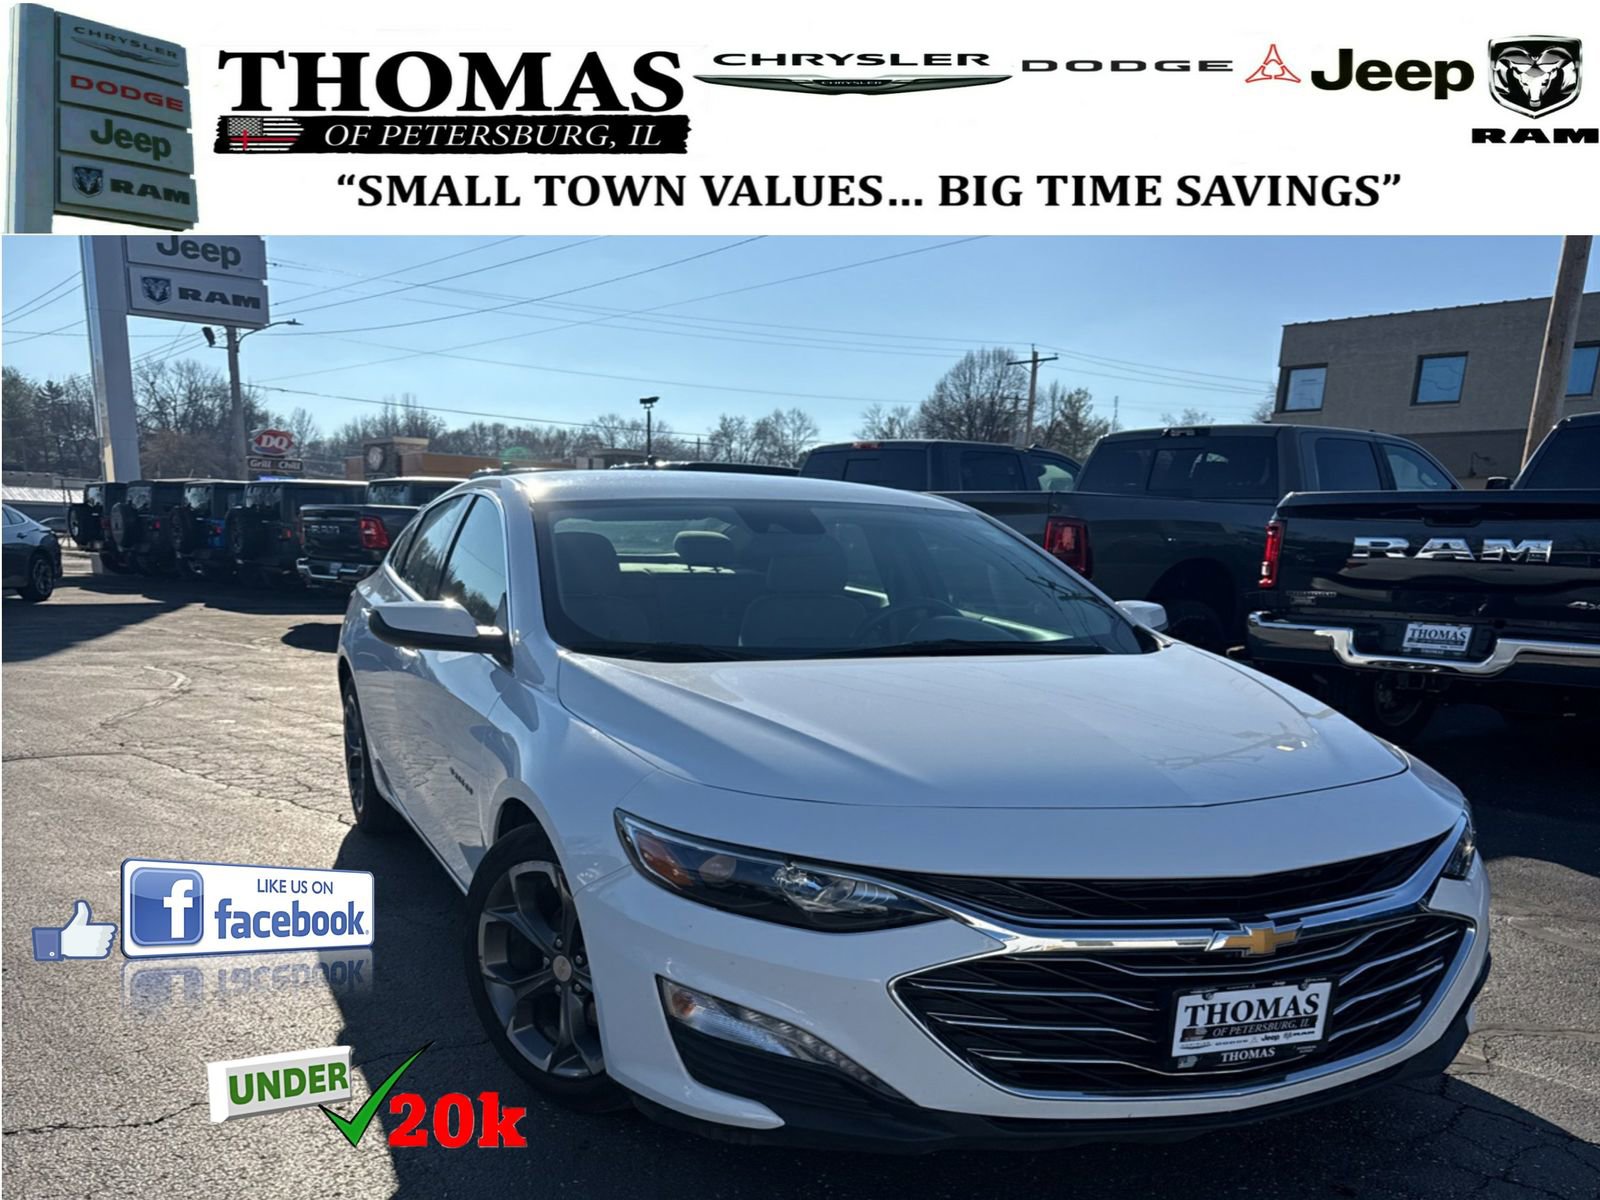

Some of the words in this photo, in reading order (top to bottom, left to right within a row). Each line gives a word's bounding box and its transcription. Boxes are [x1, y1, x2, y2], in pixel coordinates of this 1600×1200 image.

[156, 235, 241, 270] Jeep
[178, 286, 261, 309] RAM
[261, 435, 289, 451] DQ
[250, 459, 272, 468] Grill
[1351, 536, 1554, 563] RAM
[1409, 627, 1467, 642] THOMAS
[1184, 993, 1320, 1028] THOMAS
[1212, 1028, 1228, 1038] OF
[1229, 1020, 1298, 1036] PETERSBURG,
[1220, 1047, 1276, 1063] THOMAS
